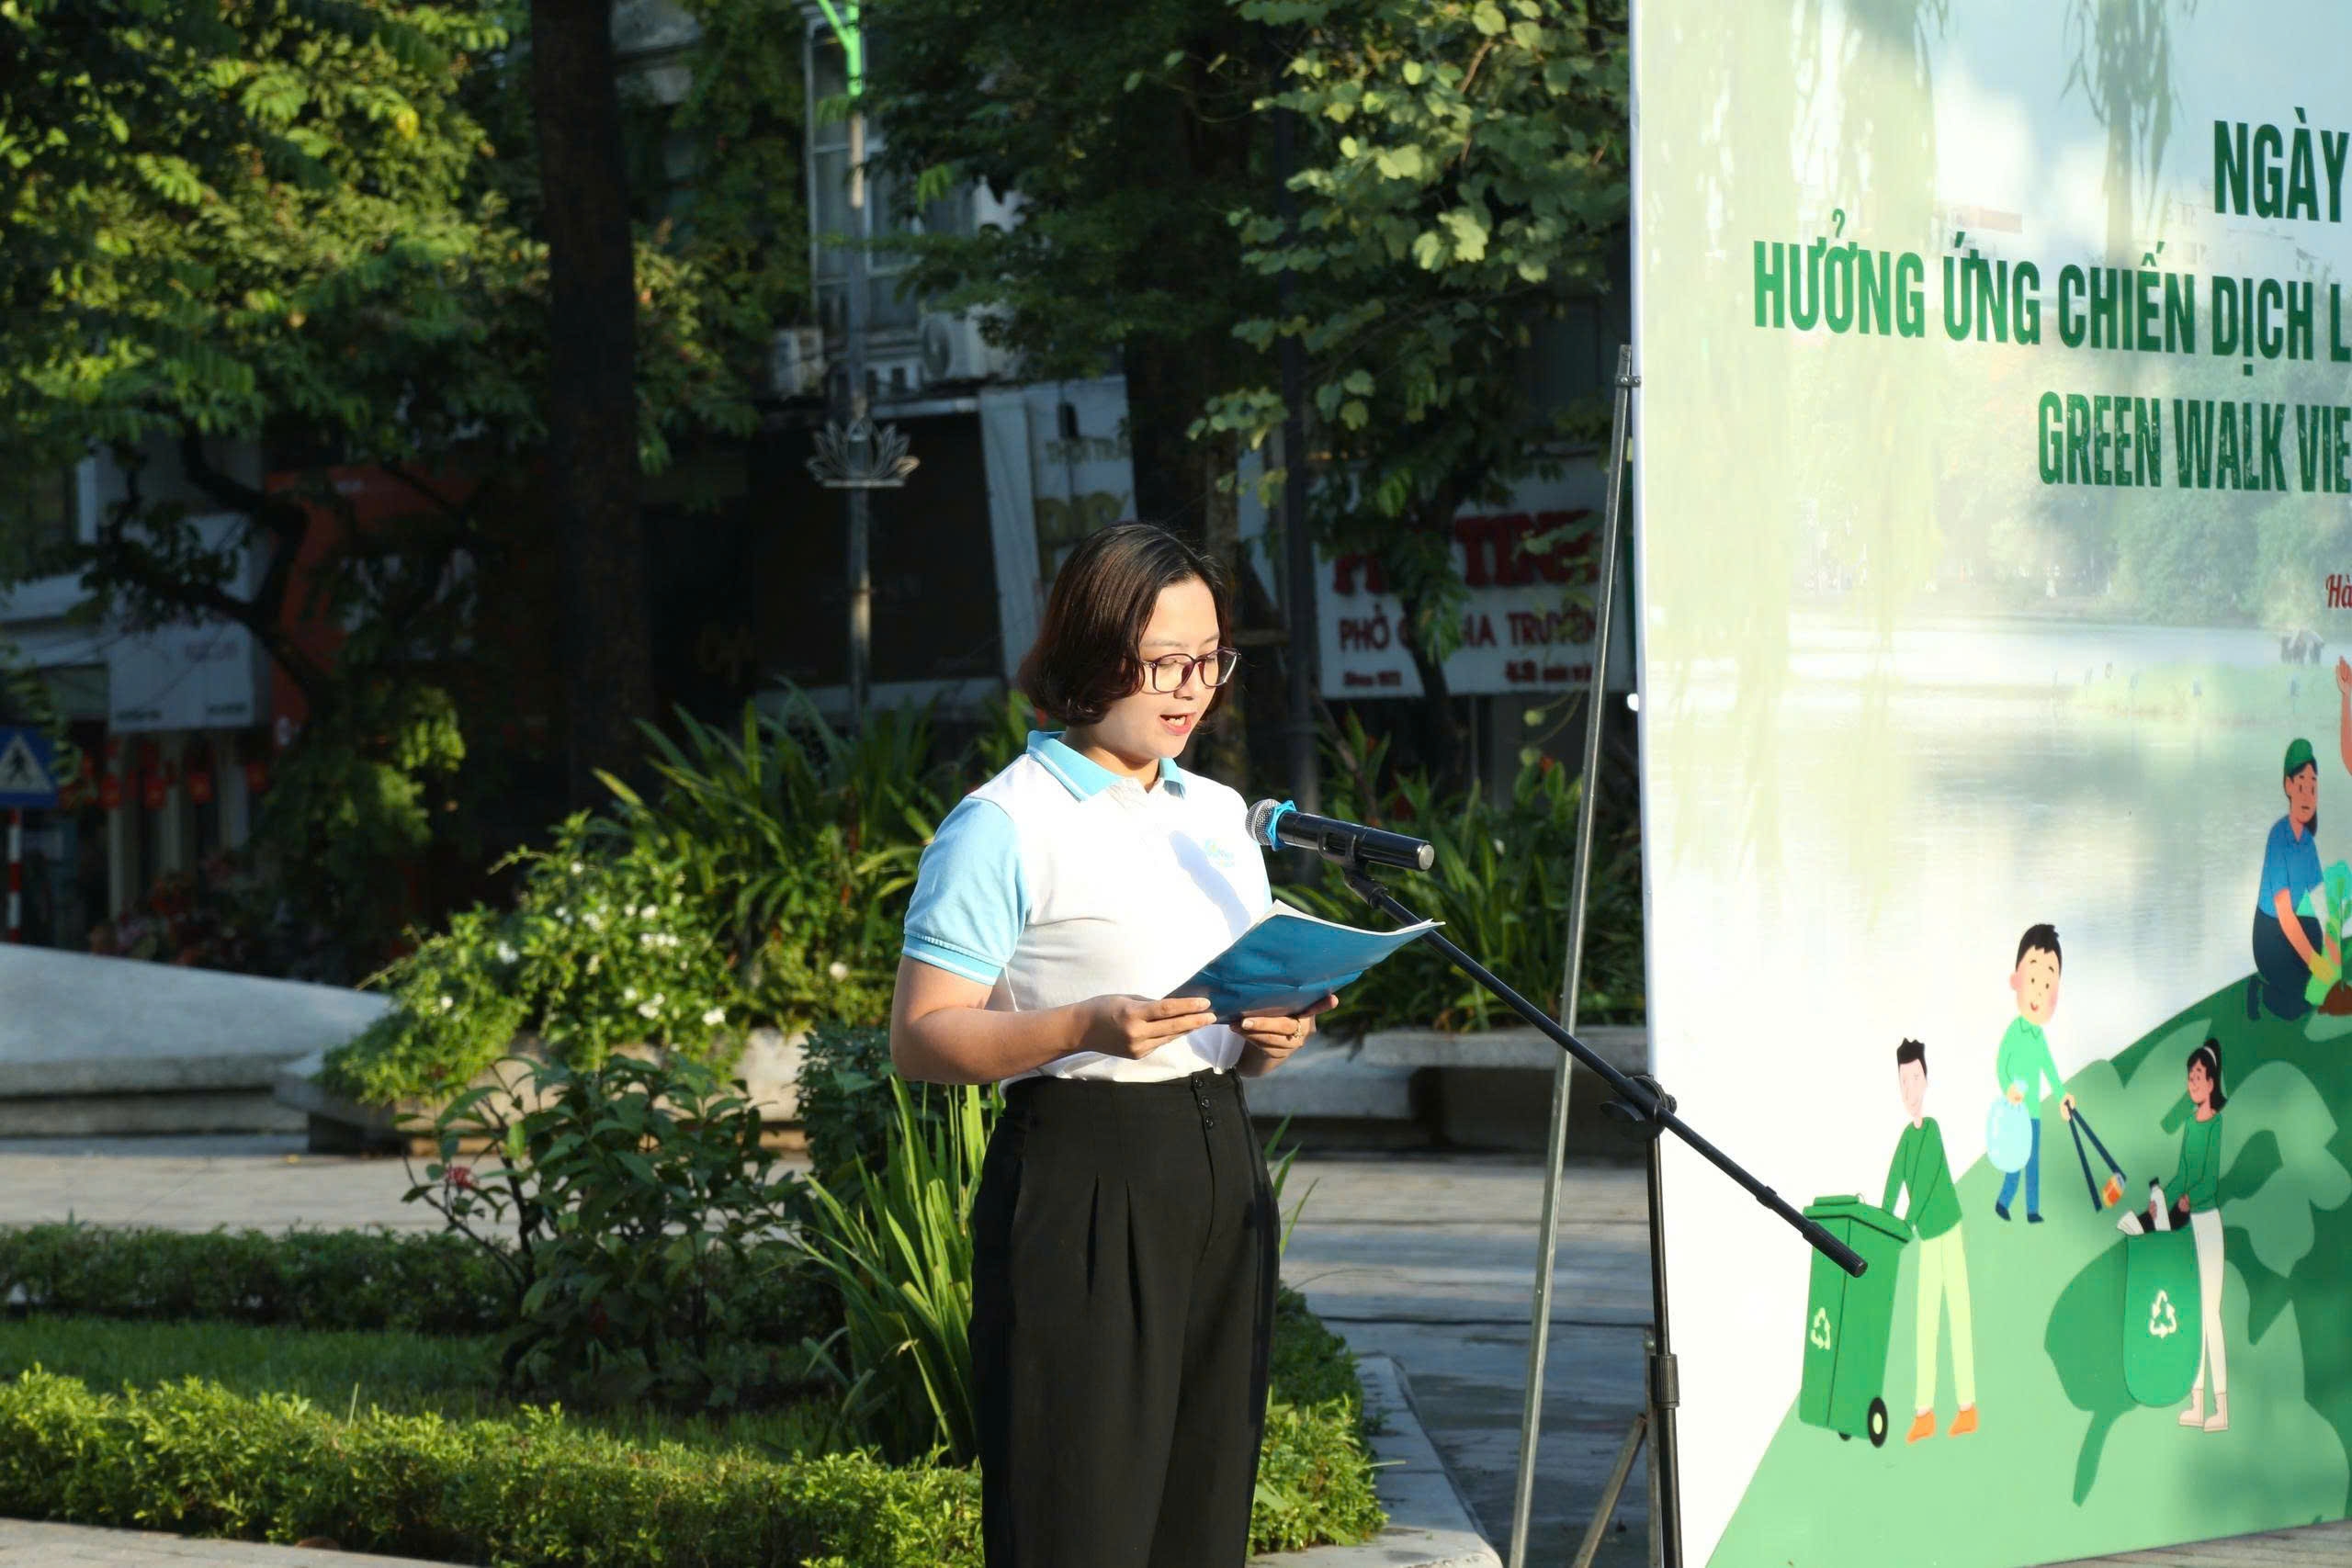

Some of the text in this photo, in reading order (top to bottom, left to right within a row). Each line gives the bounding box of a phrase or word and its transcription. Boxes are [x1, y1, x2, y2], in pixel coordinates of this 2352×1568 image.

[2214, 107, 2350, 222] NGÀY
[1754, 209, 1925, 337] HƯỞNG
[1943, 231, 2041, 344] ỨNG
[2058, 242, 2195, 355] CHIẾN
[2212, 276, 2314, 376] DỊCH
[2039, 392, 2352, 493] GREEN WALK VIE
